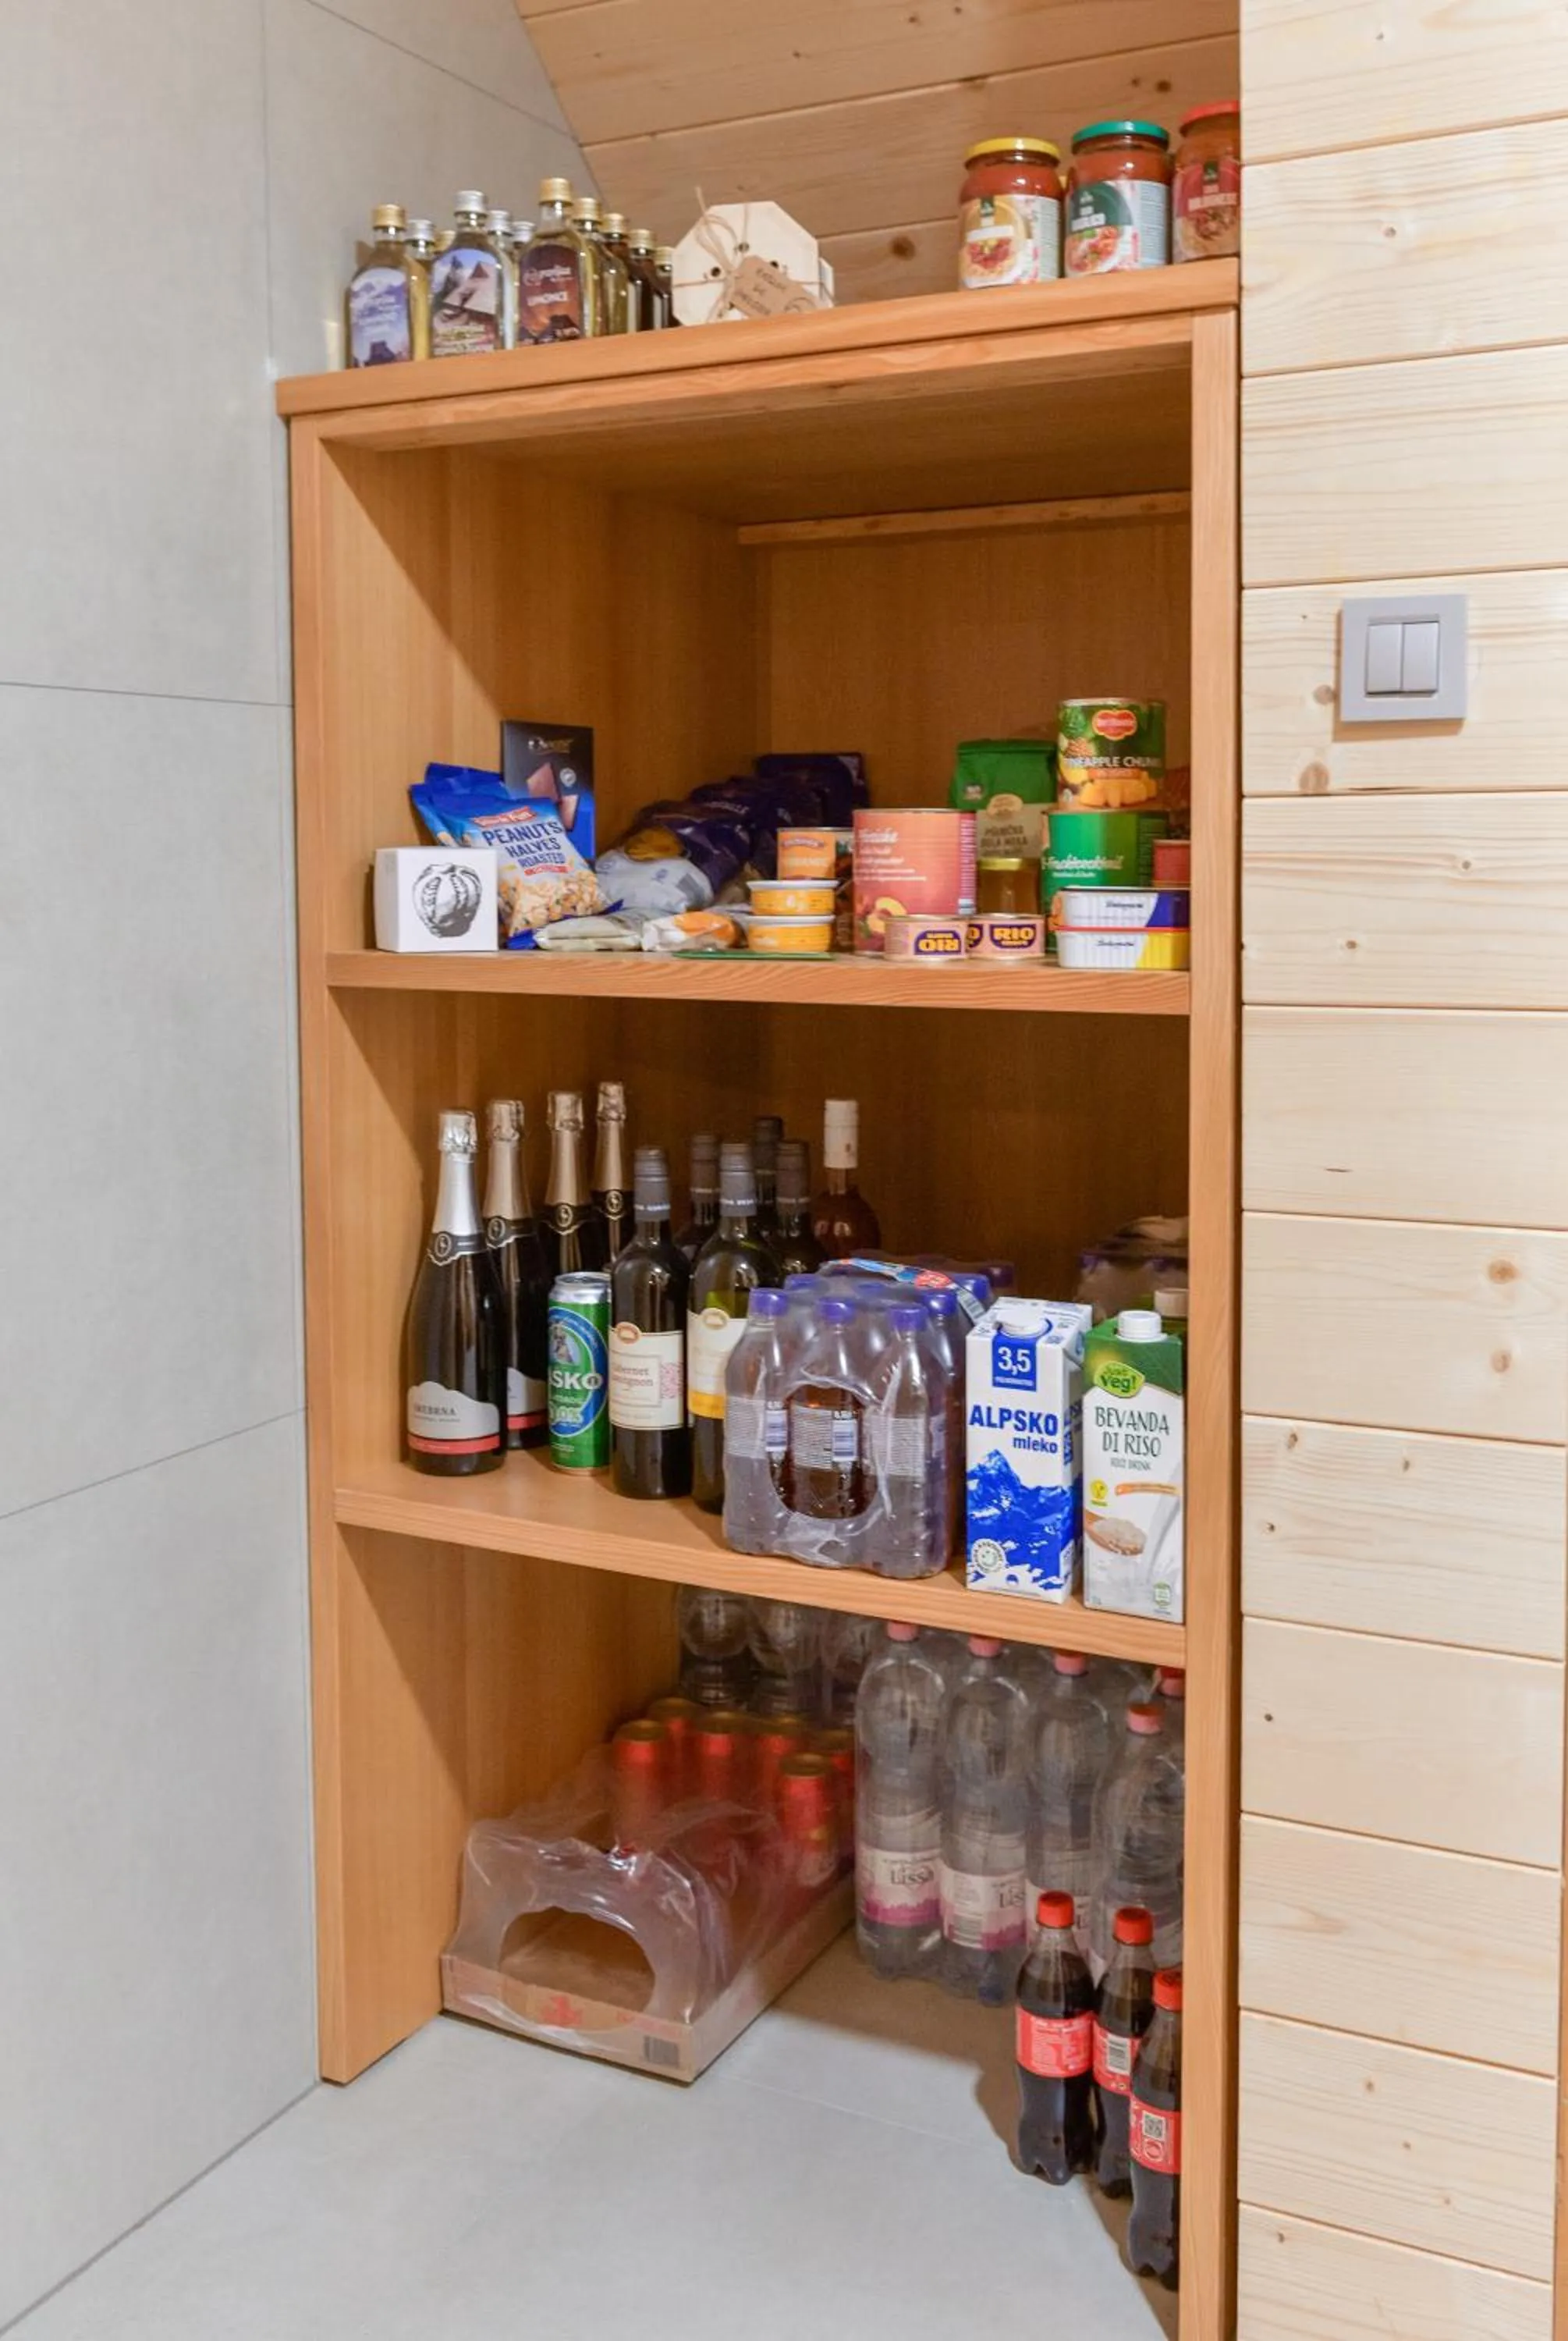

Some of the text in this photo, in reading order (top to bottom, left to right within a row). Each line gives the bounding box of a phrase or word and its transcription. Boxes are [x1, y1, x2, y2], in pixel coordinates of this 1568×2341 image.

[481, 822, 562, 847] PEANUTS
[505, 837, 561, 858] HALVES
[919, 938, 960, 951] RIO
[993, 927, 1034, 941] RIO
[998, 1347, 1031, 1376] 3,5
[969, 1404, 1058, 1436] ALPSKO
[1094, 1405, 1170, 1436] BEVANDA
[1013, 1437, 1058, 1454] mleko
[1102, 1430, 1162, 1458] DI RISO
